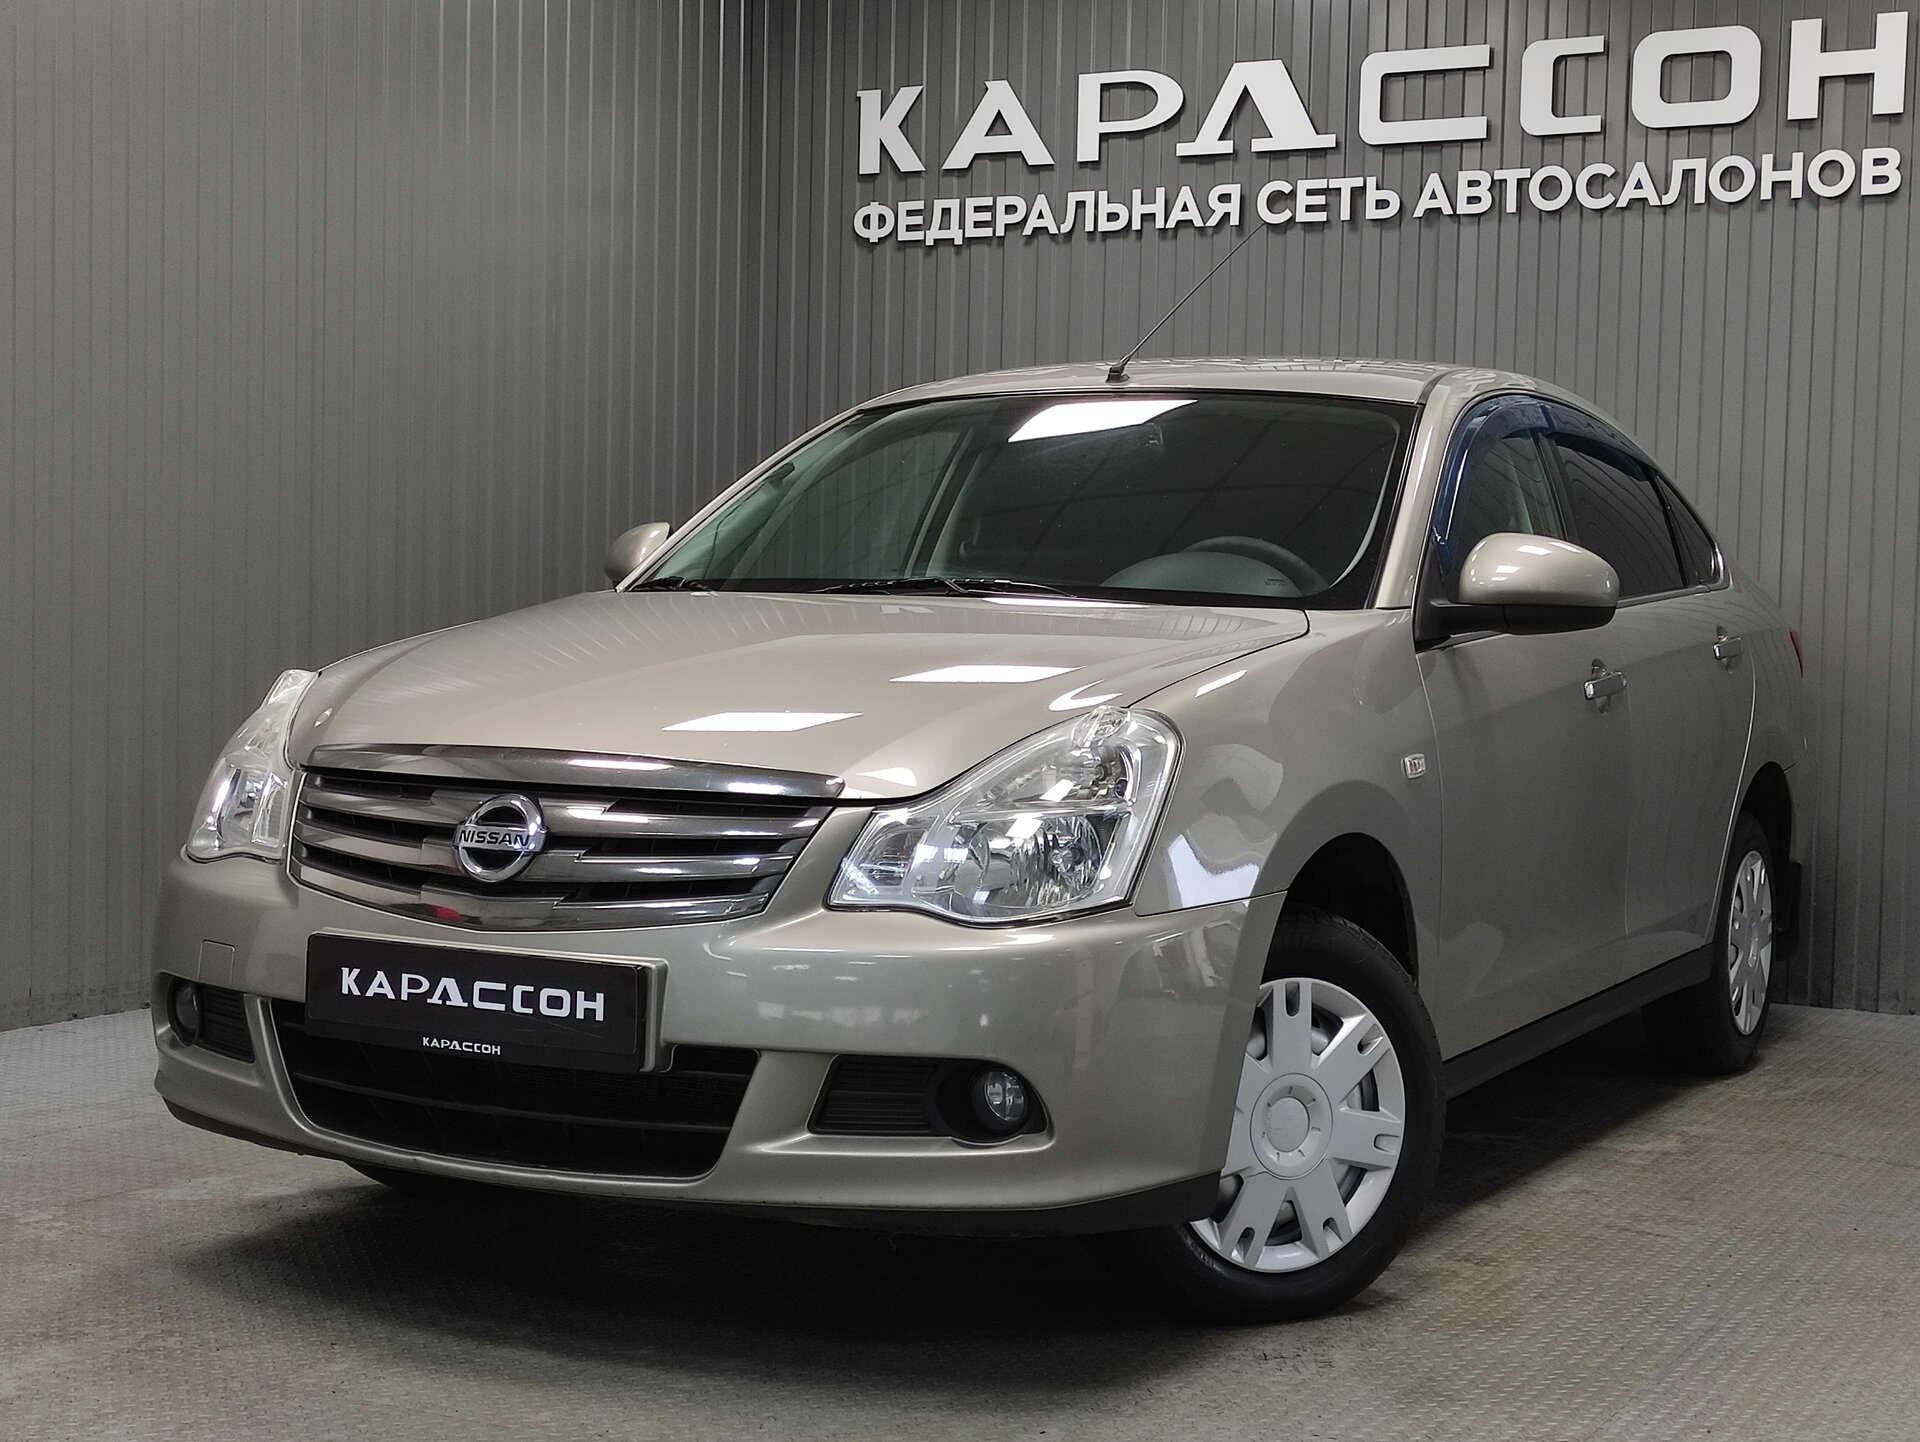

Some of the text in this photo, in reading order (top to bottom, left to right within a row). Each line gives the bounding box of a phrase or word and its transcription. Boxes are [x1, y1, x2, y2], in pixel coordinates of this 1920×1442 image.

[853, 147, 1902, 246] ФЕДЕРАЛЬНАЯ СЕТЬ АВТОСАЛОНОВ
[459, 829, 531, 847] NISSAN
